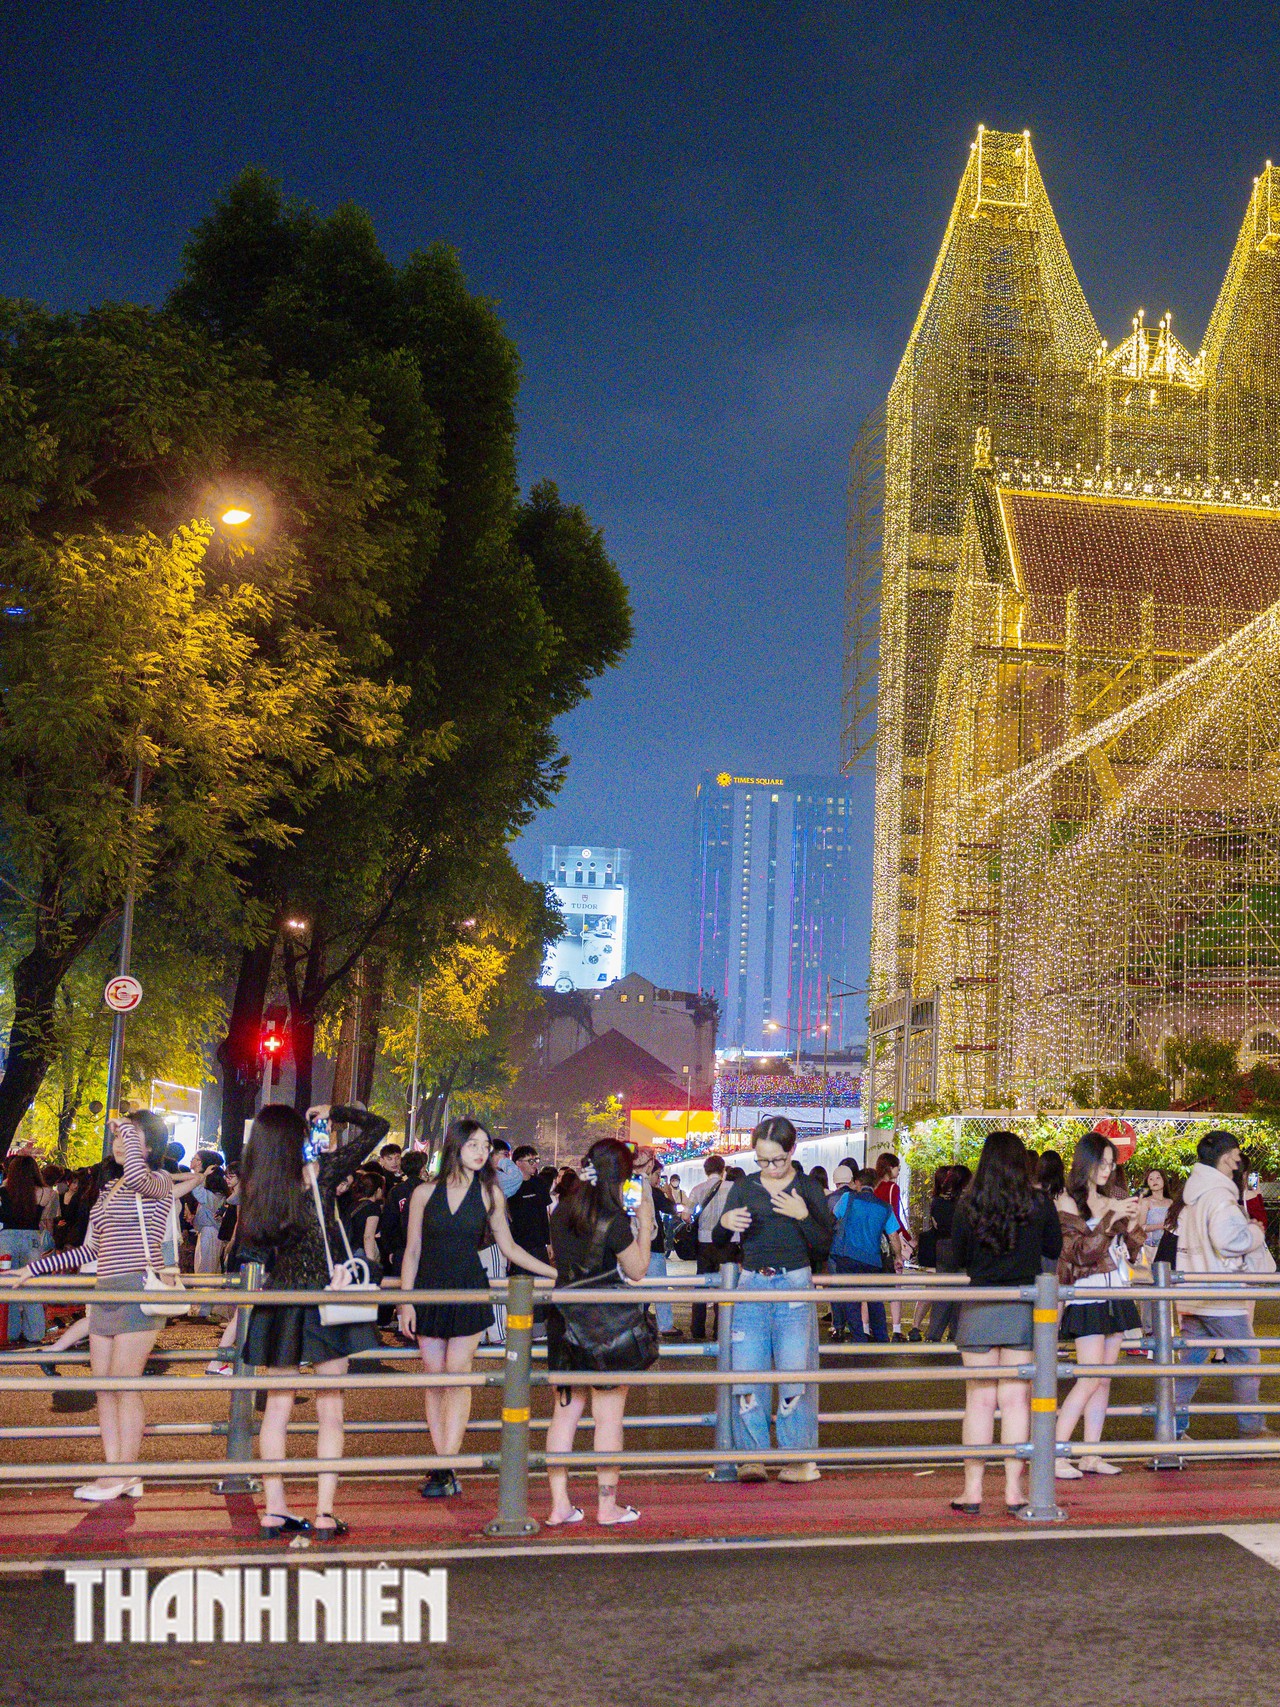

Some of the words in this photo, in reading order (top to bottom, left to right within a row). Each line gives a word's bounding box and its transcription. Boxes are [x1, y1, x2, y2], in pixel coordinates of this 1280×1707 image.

[733, 776, 755, 785] TIMES
[755, 777, 784, 786] SQUARE
[571, 902, 598, 910] TUDOR
